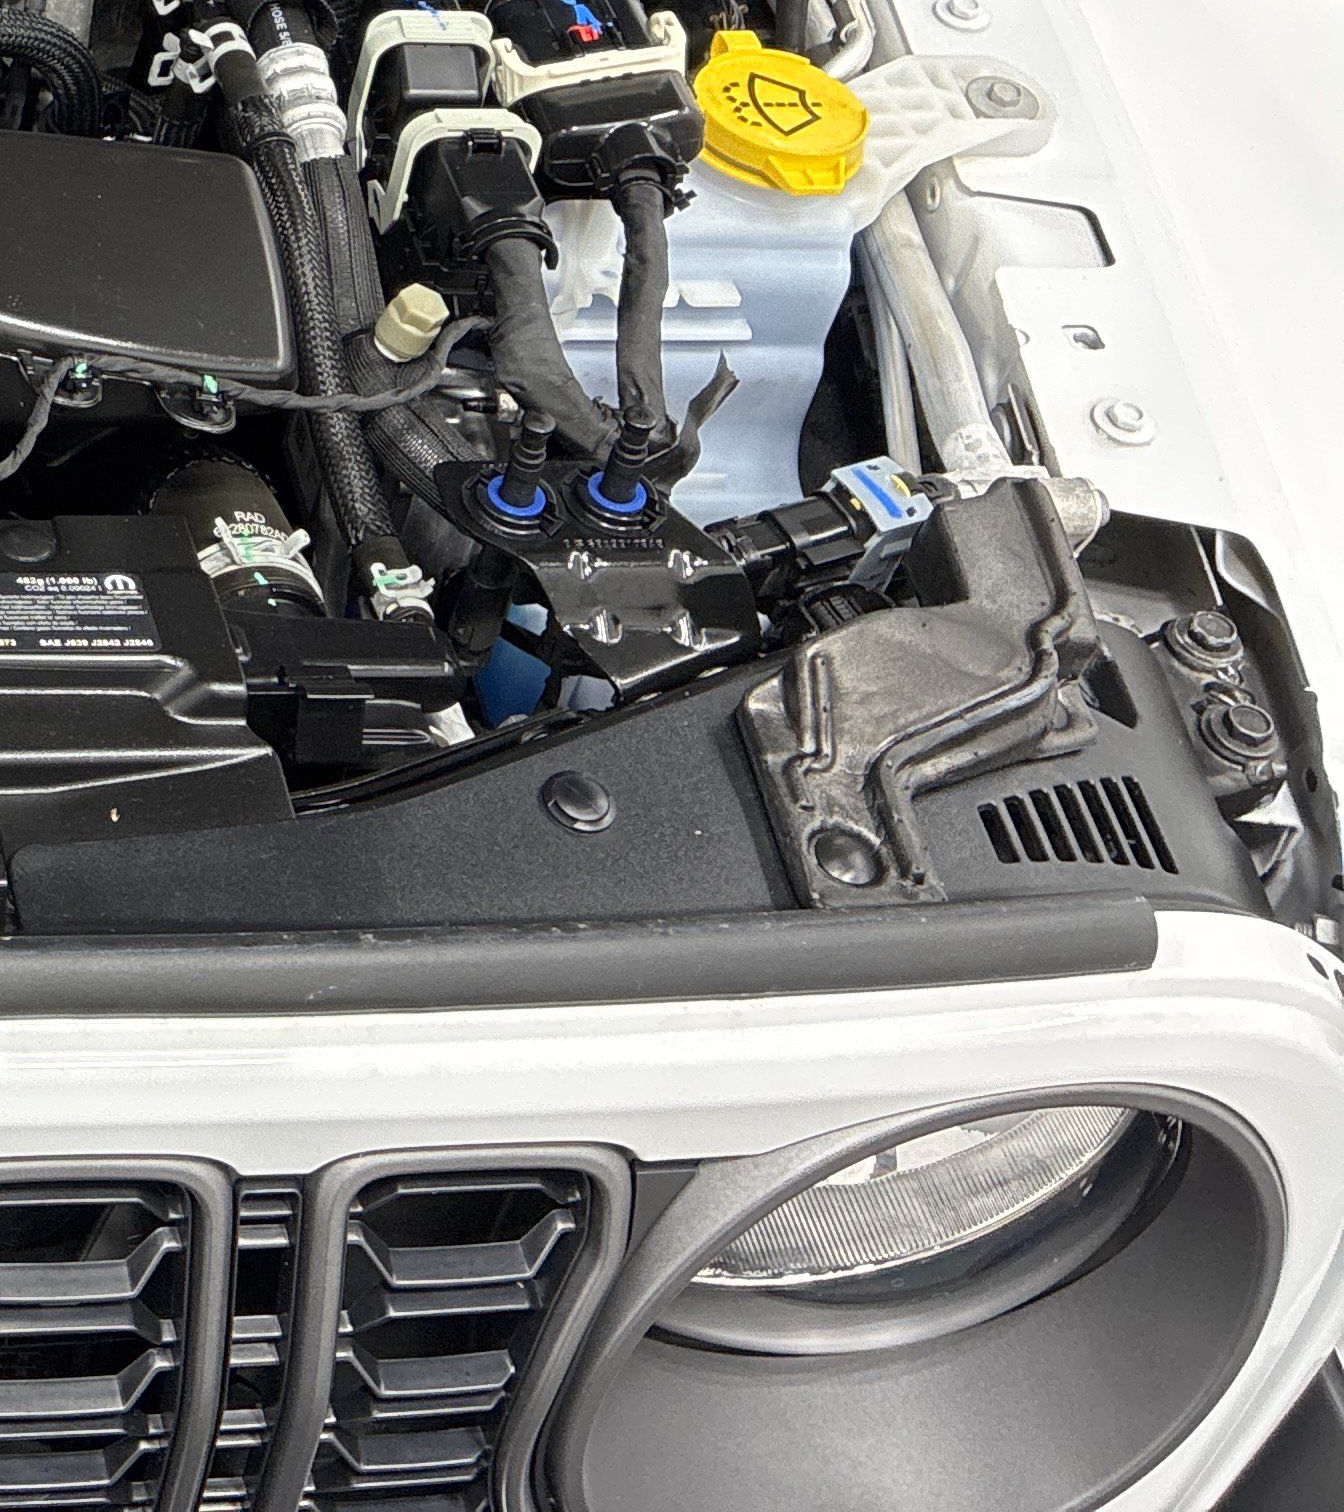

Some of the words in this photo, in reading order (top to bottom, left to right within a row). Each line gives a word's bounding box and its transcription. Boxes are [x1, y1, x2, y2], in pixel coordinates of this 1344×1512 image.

[270, 2, 288, 31] HOSE
[233, 510, 266, 524] RAD
[212, 522, 290, 543] 6280782AD
